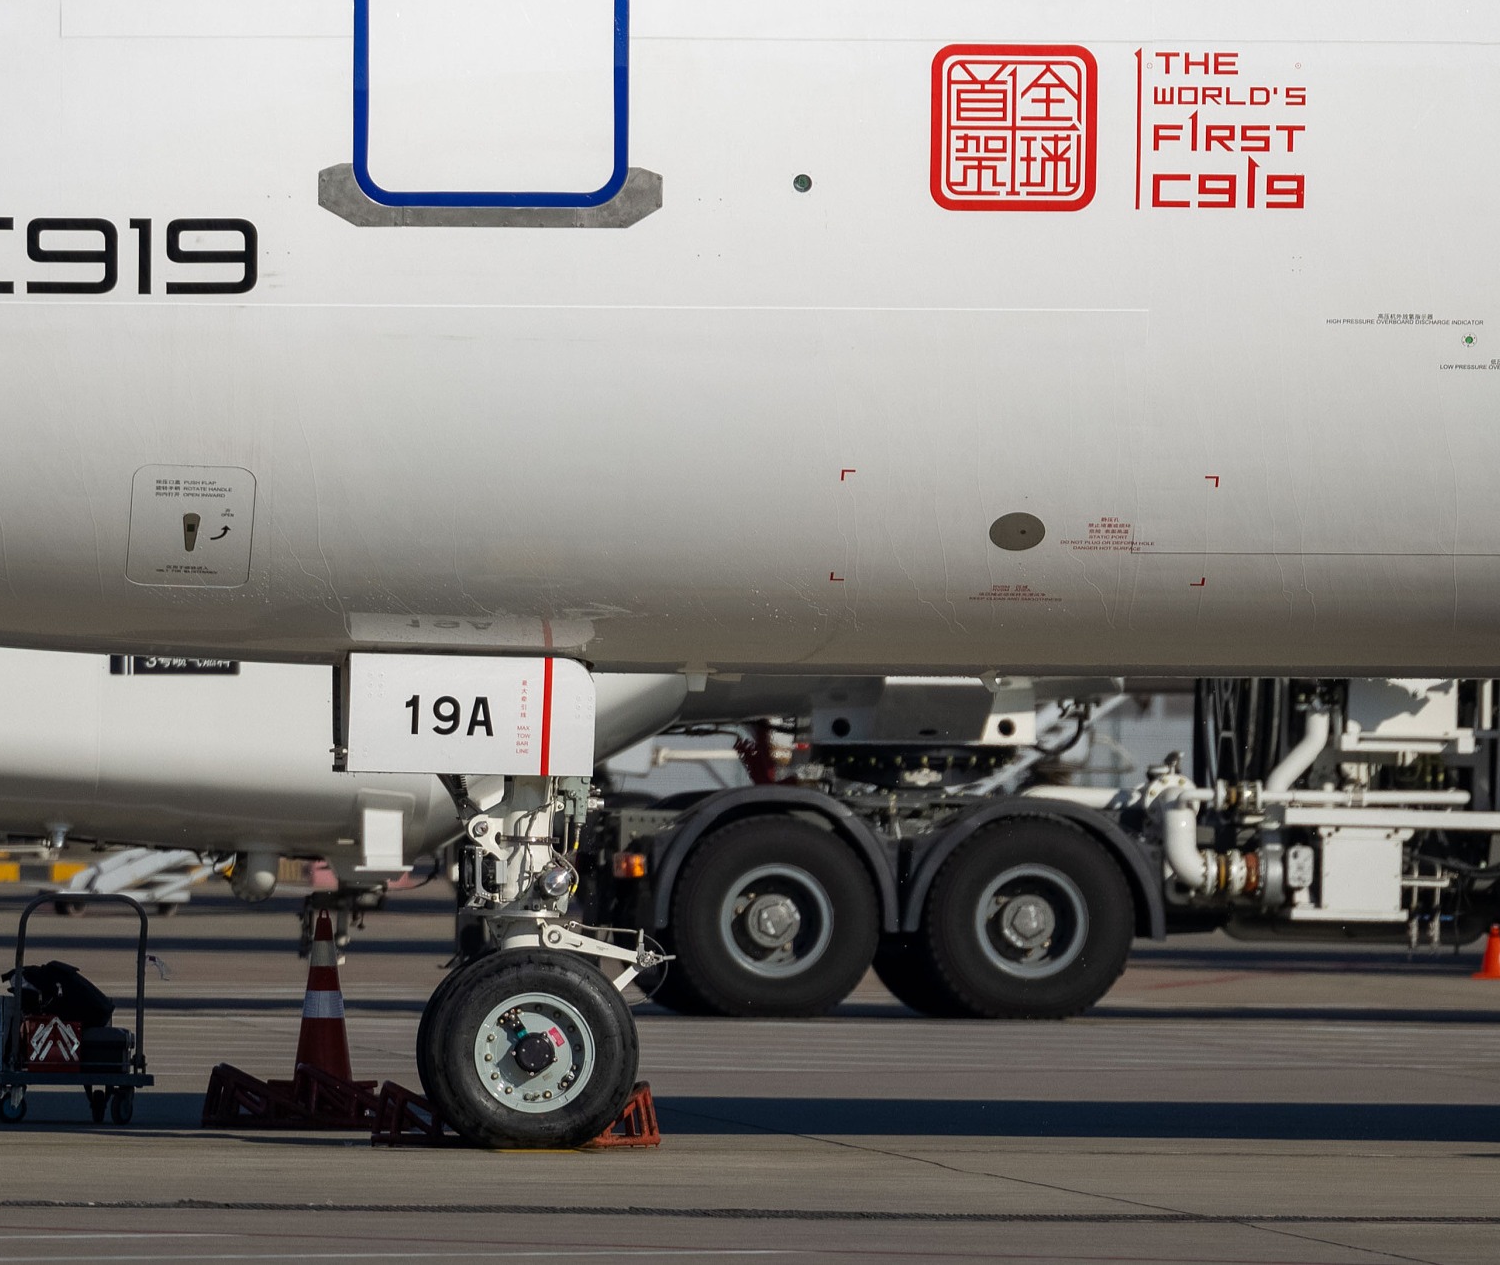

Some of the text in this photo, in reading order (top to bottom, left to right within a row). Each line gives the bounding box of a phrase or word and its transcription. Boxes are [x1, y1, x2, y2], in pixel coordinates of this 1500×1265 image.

[1155, 52, 1239, 75] THE
[1153, 86, 1306, 106] WORLD'S
[1153, 109, 1306, 152] FIRST
[1152, 155, 1305, 209] C919
[405, 694, 494, 737] 19A
